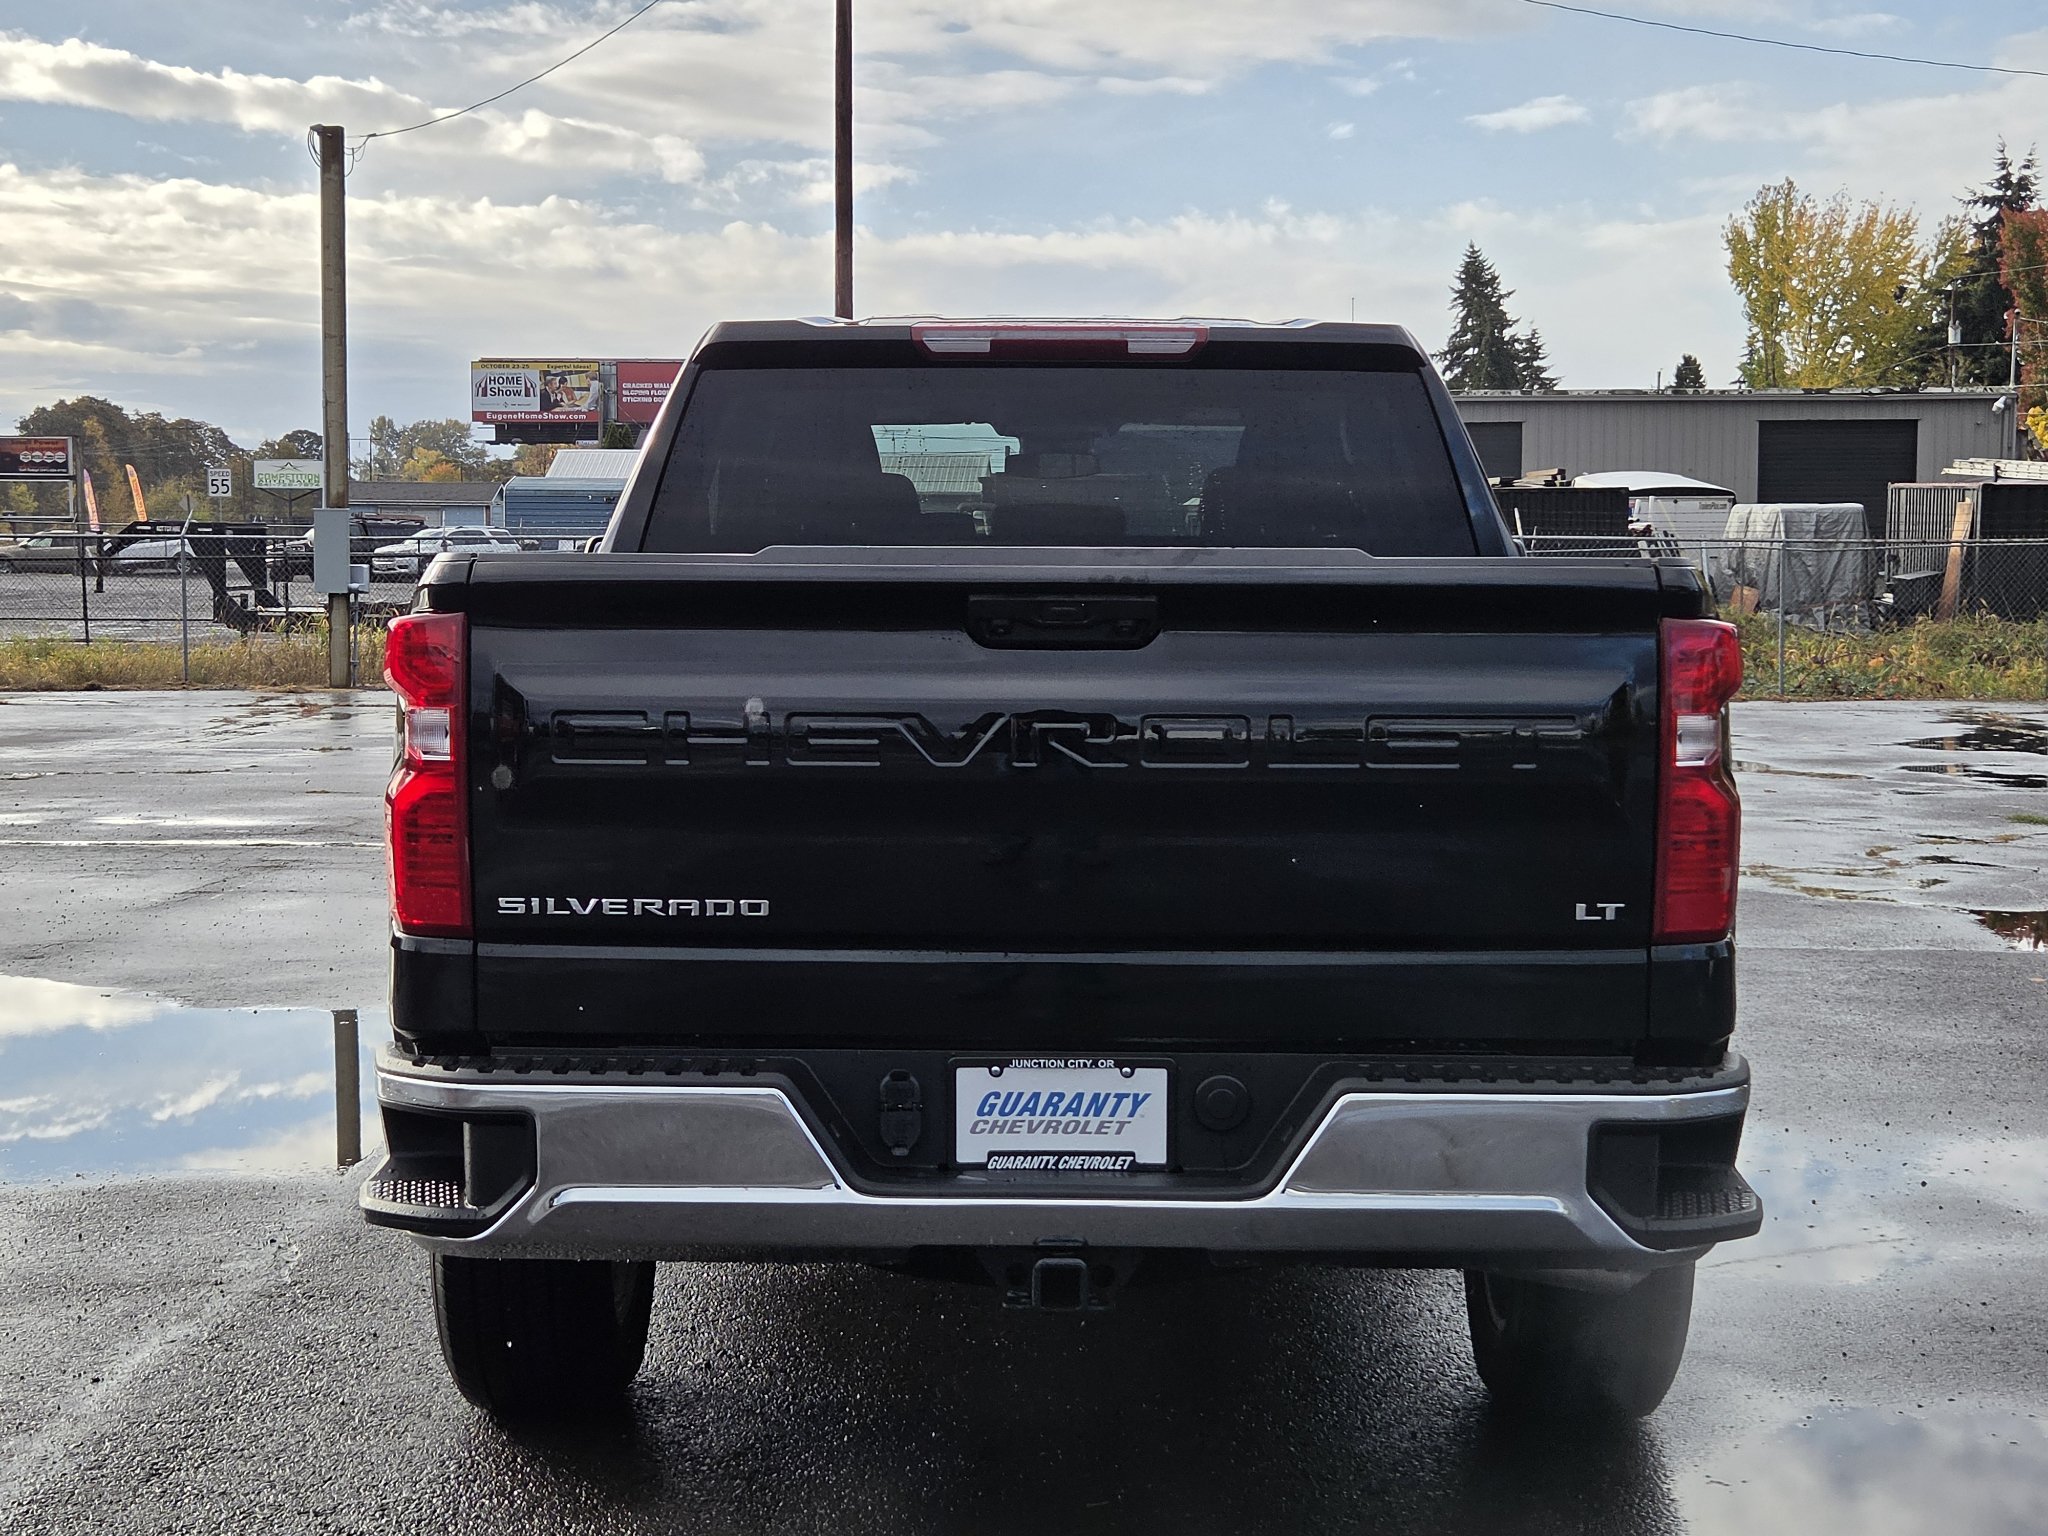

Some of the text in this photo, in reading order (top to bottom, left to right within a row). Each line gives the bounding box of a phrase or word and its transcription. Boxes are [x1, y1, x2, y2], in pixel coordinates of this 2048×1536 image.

[488, 376, 523, 386] HOME
[488, 387, 523, 398] Show
[486, 413, 587, 421] EugeneHomeShow.com
[257, 473, 320, 481] COMPETITION
[211, 479, 230, 494] 55
[551, 710, 1578, 771] CHEVROLET
[497, 897, 770, 917] SILVERADO
[1575, 903, 1626, 920] LT
[1009, 1059, 1066, 1069] JUNCTION
[1098, 1059, 1115, 1069] OR
[976, 1091, 1152, 1119] GUARANTY
[969, 1119, 1132, 1136] CHEVROLET
[1058, 1156, 1134, 1170] CHEVROLET
